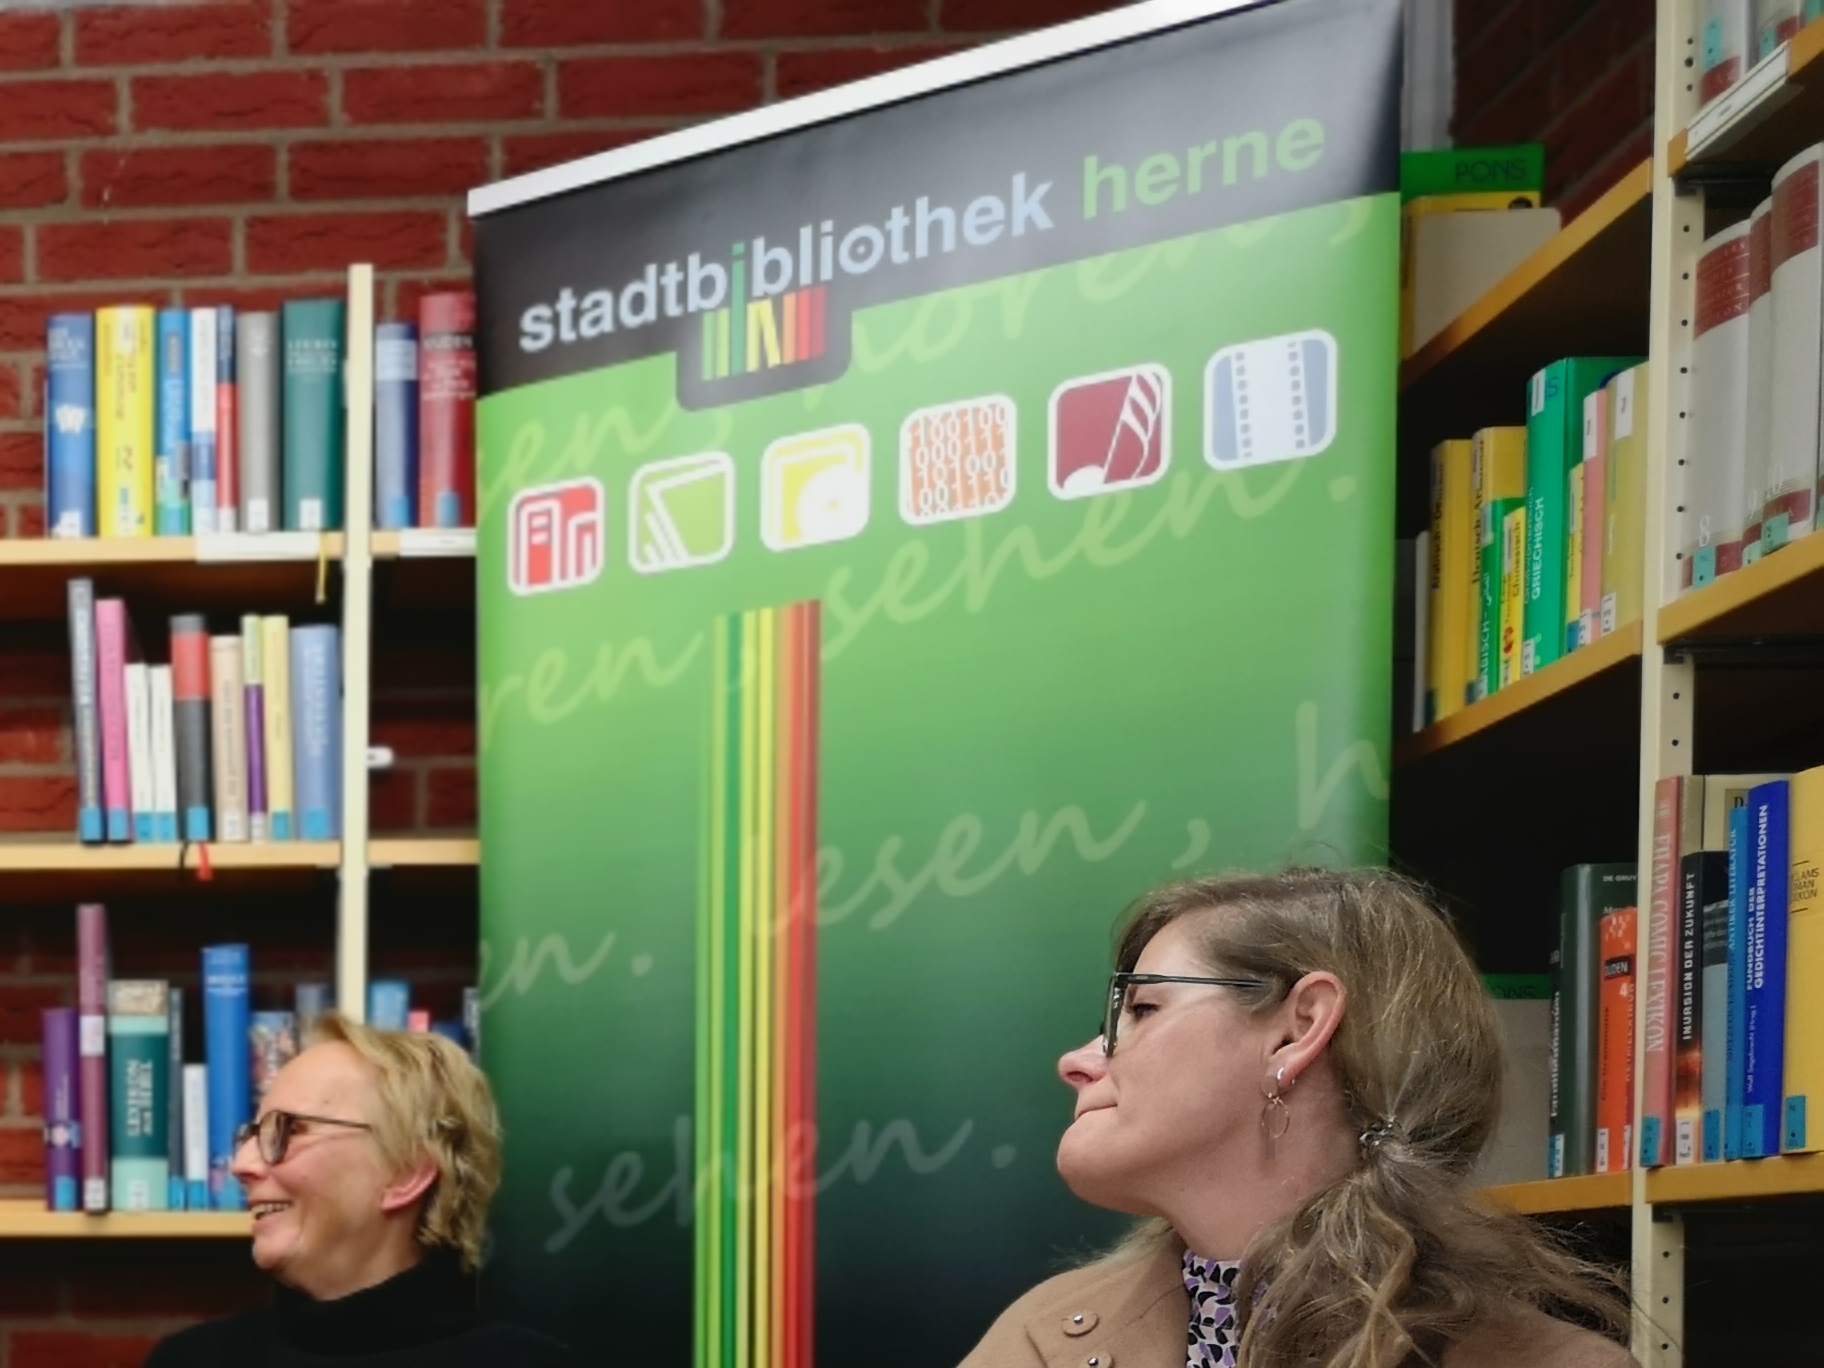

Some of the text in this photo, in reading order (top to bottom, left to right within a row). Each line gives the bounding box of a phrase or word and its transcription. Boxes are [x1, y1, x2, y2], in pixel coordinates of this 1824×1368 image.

[1455, 158, 1527, 183] PONS
[518, 117, 1326, 372] stadtbibliothek herne
[1531, 497, 1544, 600] GRIECHISCH
[1616, 874, 1638, 882] GRUY
[1653, 834, 1670, 892] EHAPA
[1684, 873, 1696, 934] ZUKUNFT
[1754, 804, 1768, 990] GEDICHTINTERPRETATIONEN
[1649, 901, 1670, 957] COMIC
[1684, 940, 1695, 972] DER
[1746, 918, 1755, 991] FUNDBUCH
[1618, 982, 1627, 998] 4
[1646, 965, 1669, 1053] LEXIKON
